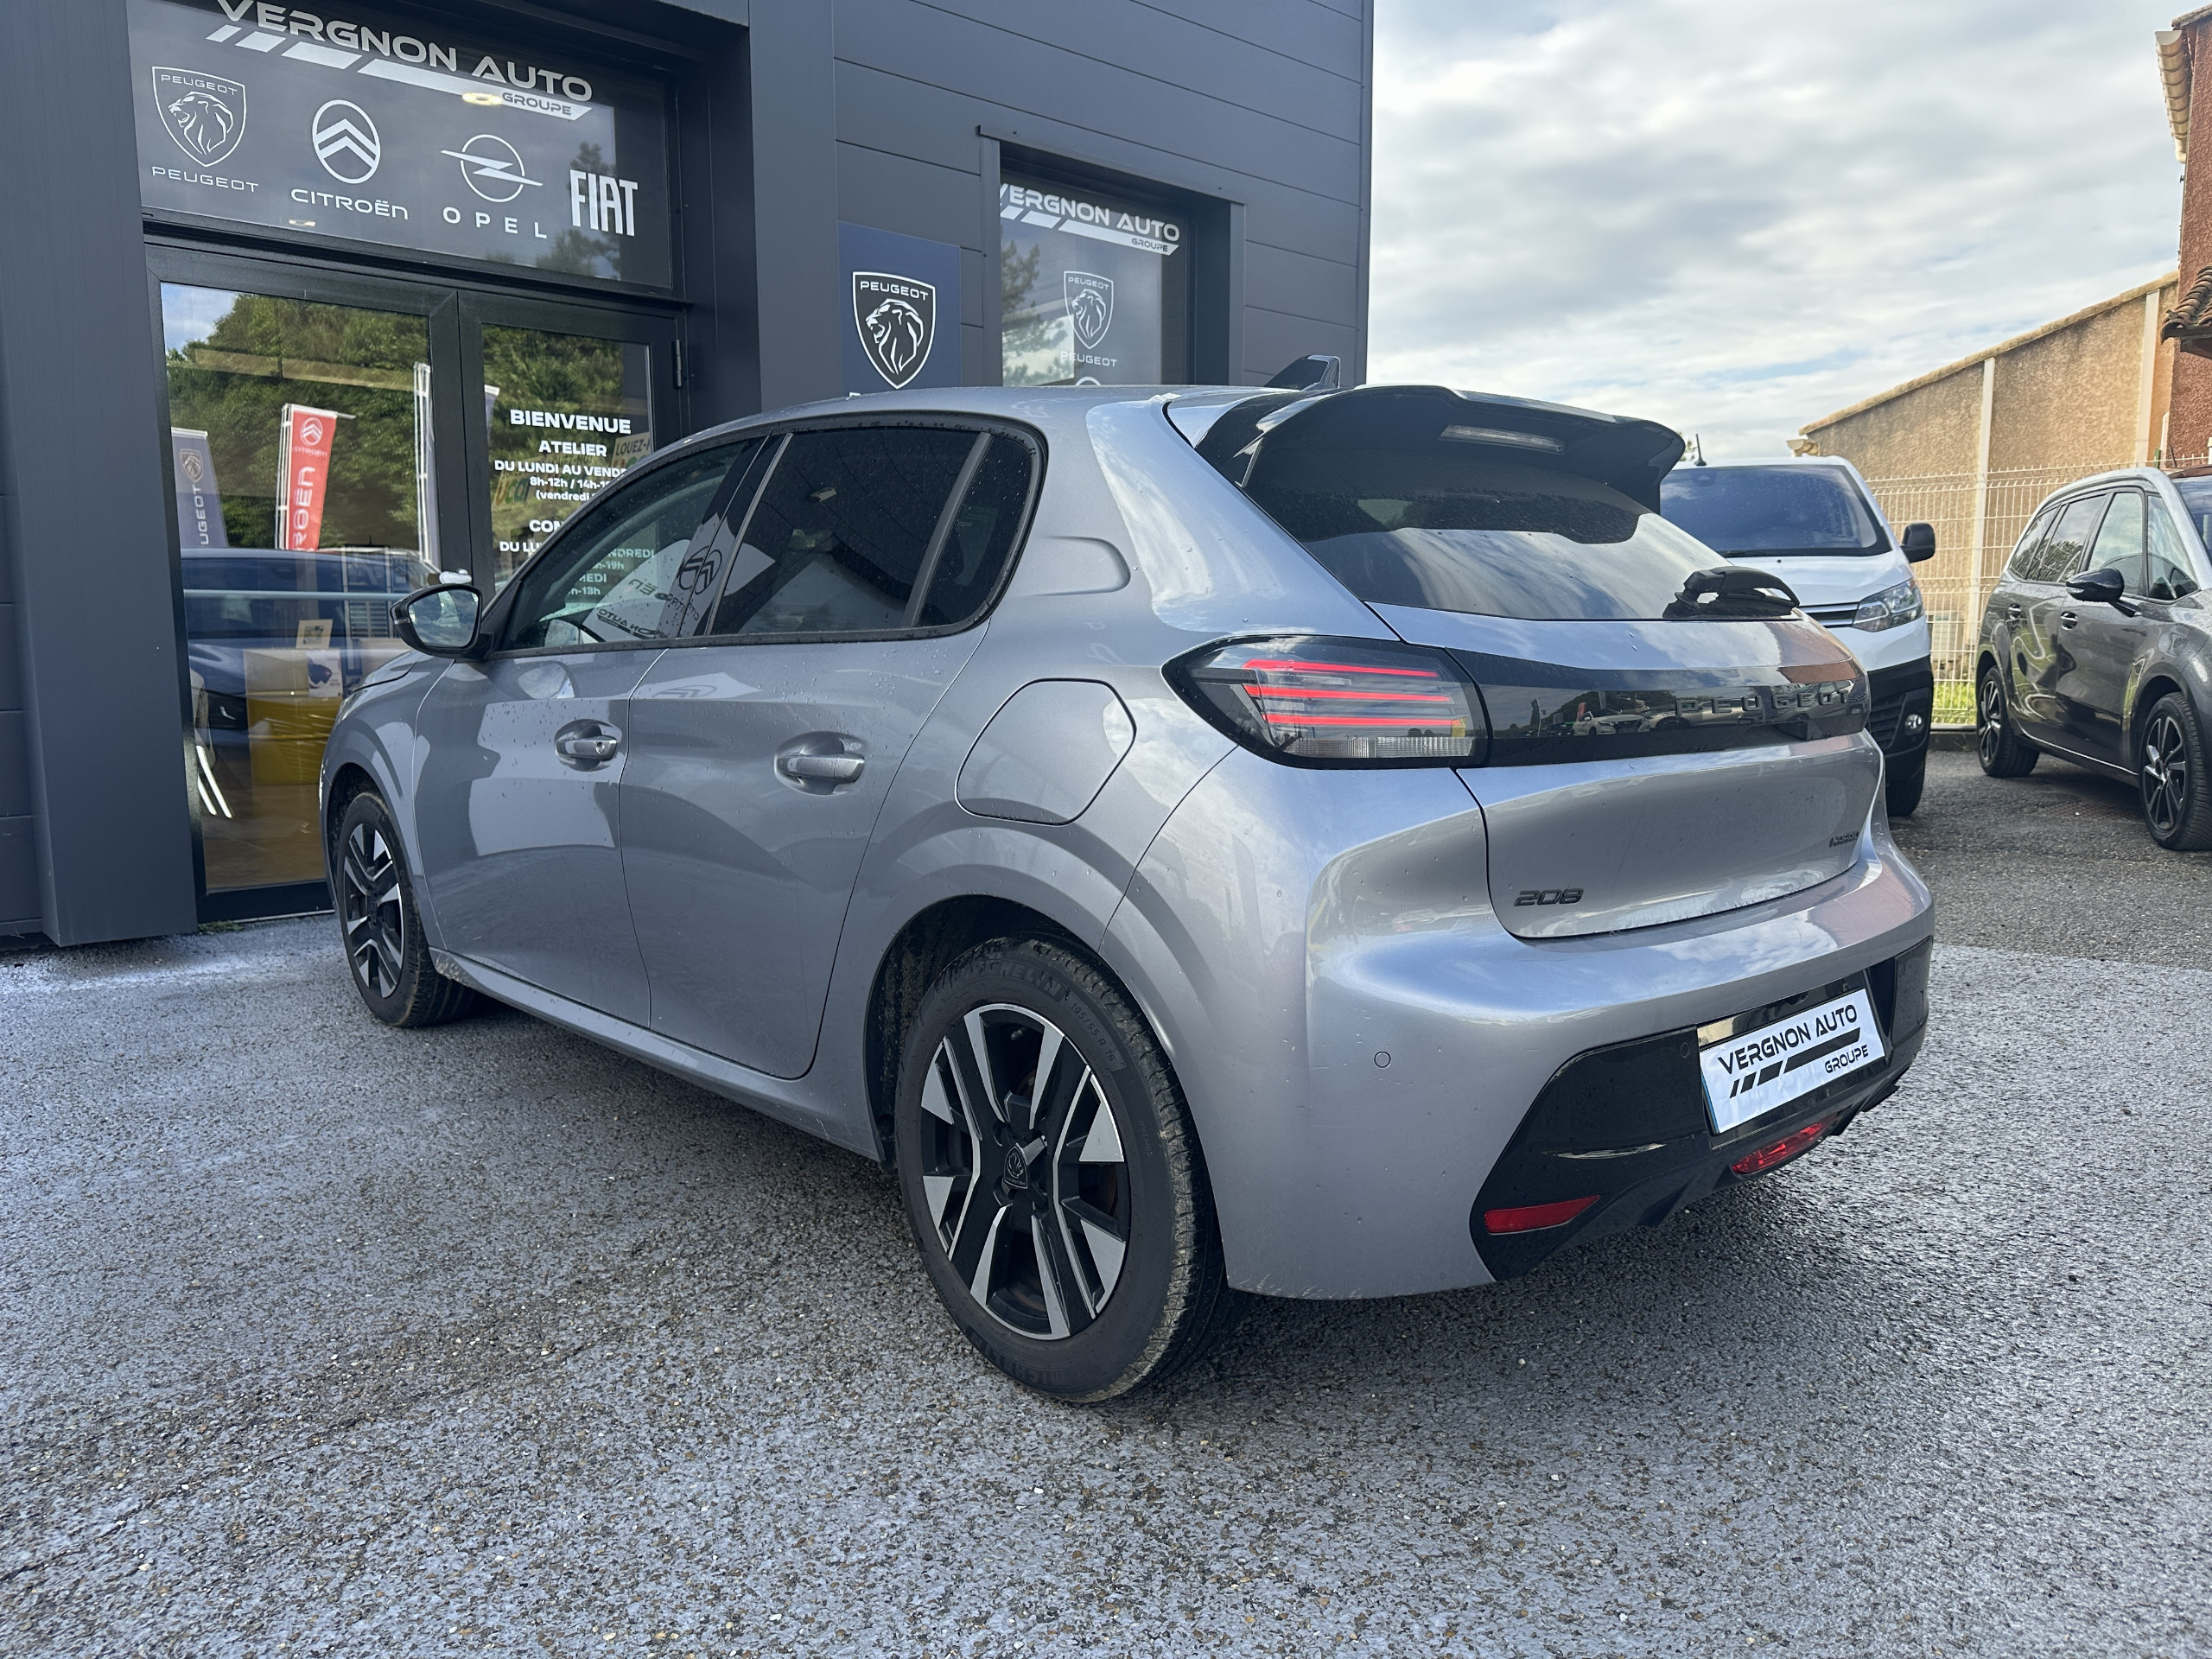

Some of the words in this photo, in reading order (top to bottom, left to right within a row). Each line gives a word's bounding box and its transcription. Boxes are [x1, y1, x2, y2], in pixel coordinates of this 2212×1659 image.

[217, 0, 457, 73] VERGNON
[472, 55, 594, 102] AUTO
[160, 74, 238, 97] PEUGEOT
[502, 92, 572, 116] GROUPE
[152, 167, 258, 193] PEUGEOT
[570, 168, 638, 237] FIAT
[442, 207, 547, 239] OPEL
[1116, 213, 1180, 242] AUTO
[1131, 238, 1168, 253] GROUPE
[860, 281, 929, 302] PEUGEOT
[1068, 276, 1109, 291] PEUGEOT
[1060, 350, 1117, 368] PEUGEOT
[510, 409, 632, 435] BIENVENUE
[538, 440, 607, 457] ATELIER
[494, 460, 515, 472] DU
[518, 461, 560, 474] LUNDI
[562, 464, 582, 476] AU
[530, 476, 568, 488] 8h-12h
[536, 491, 590, 502] (vendredi
[192, 483, 209, 545] UGEOT
[499, 541, 519, 552] DU
[523, 542, 543, 553] LU
[607, 549, 655, 559] NDREDI
[592, 561, 624, 570] h-19h
[1675, 690, 1849, 716] PEUGEOT
[1514, 887, 1585, 907] 208
[1717, 1022, 1811, 1075] VERGNON
[1815, 1004, 1858, 1038] AUTO
[1825, 1044, 1869, 1073] GROUPE
